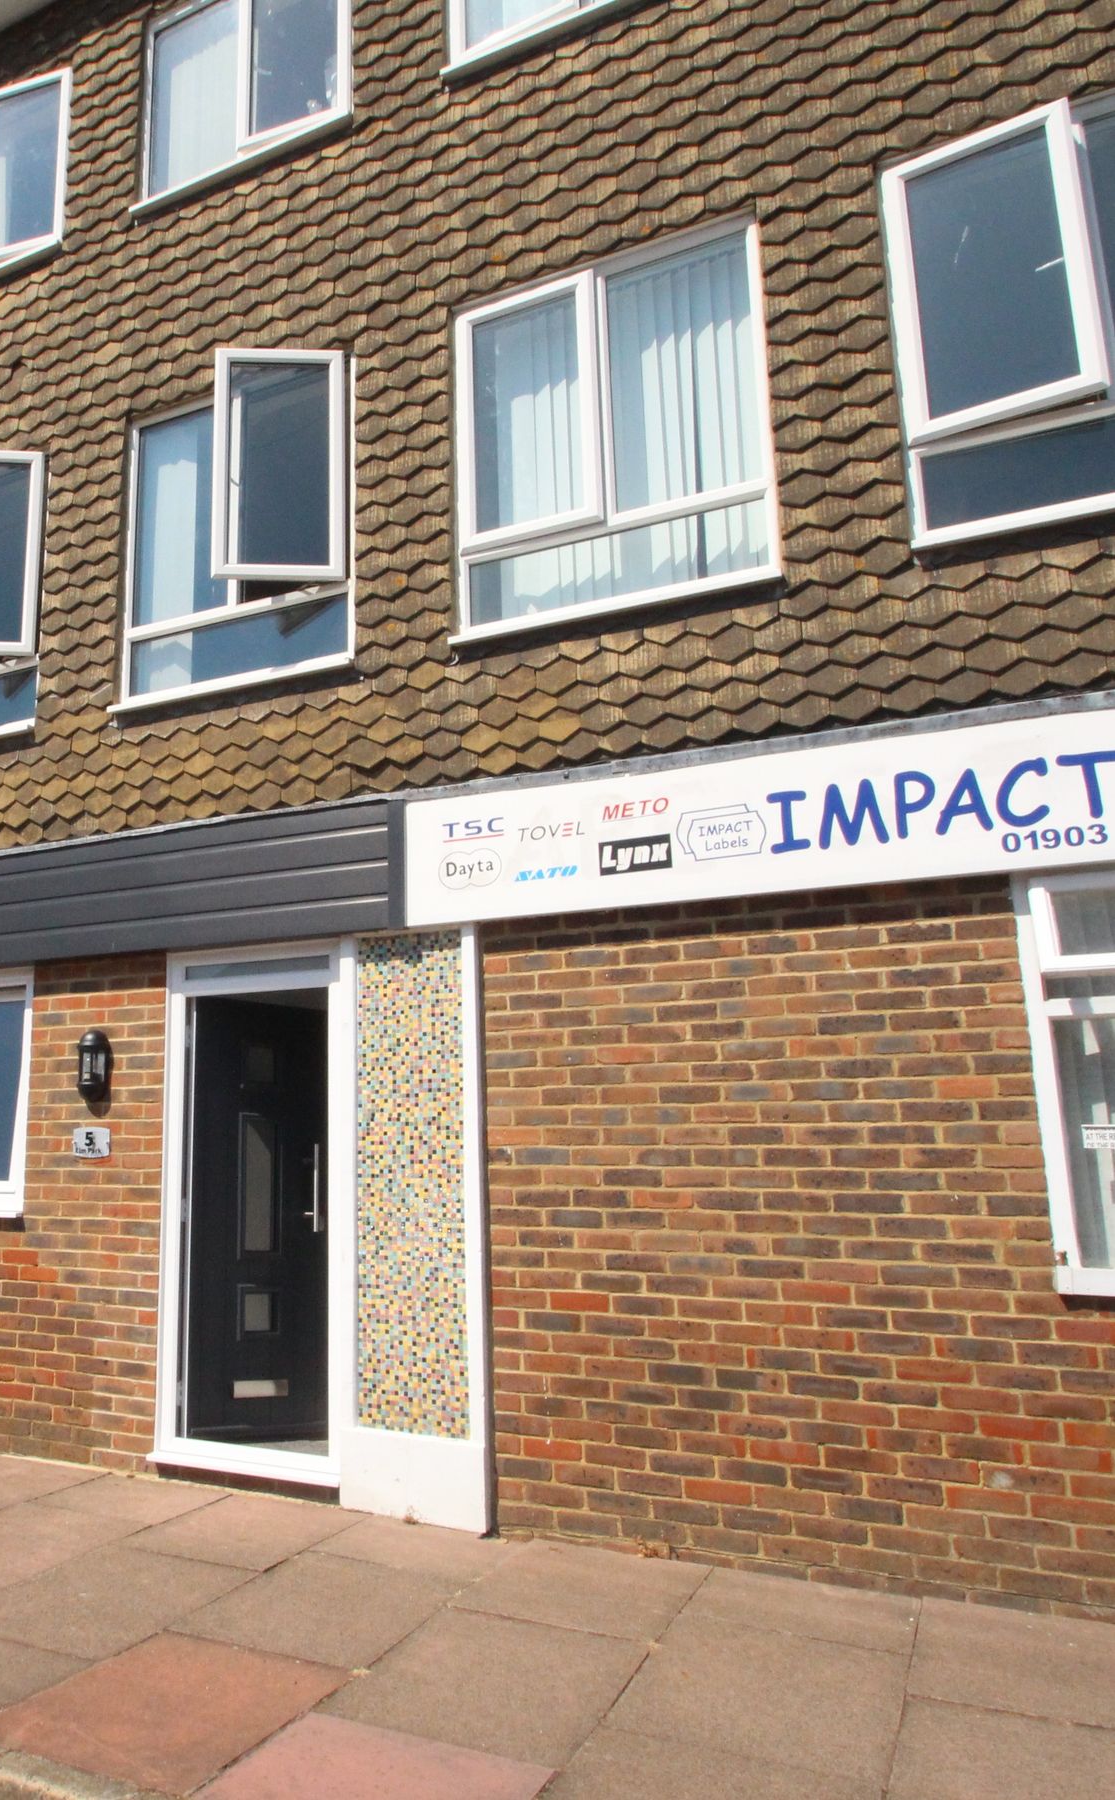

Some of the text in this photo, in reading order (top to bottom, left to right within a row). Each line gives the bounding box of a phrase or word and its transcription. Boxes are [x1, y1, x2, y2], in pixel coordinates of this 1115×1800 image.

[602, 797, 670, 821] METO
[766, 750, 1115, 855] IMPACT
[442, 817, 504, 838] TSC
[518, 821, 585, 842] TOVEL
[698, 820, 753, 838] IMPACT
[1001, 823, 1109, 853] 01903
[705, 835, 749, 852] Labels
[601, 842, 669, 871] Lynx
[446, 860, 494, 879] Dayta
[85, 1131, 93, 1146] 5
